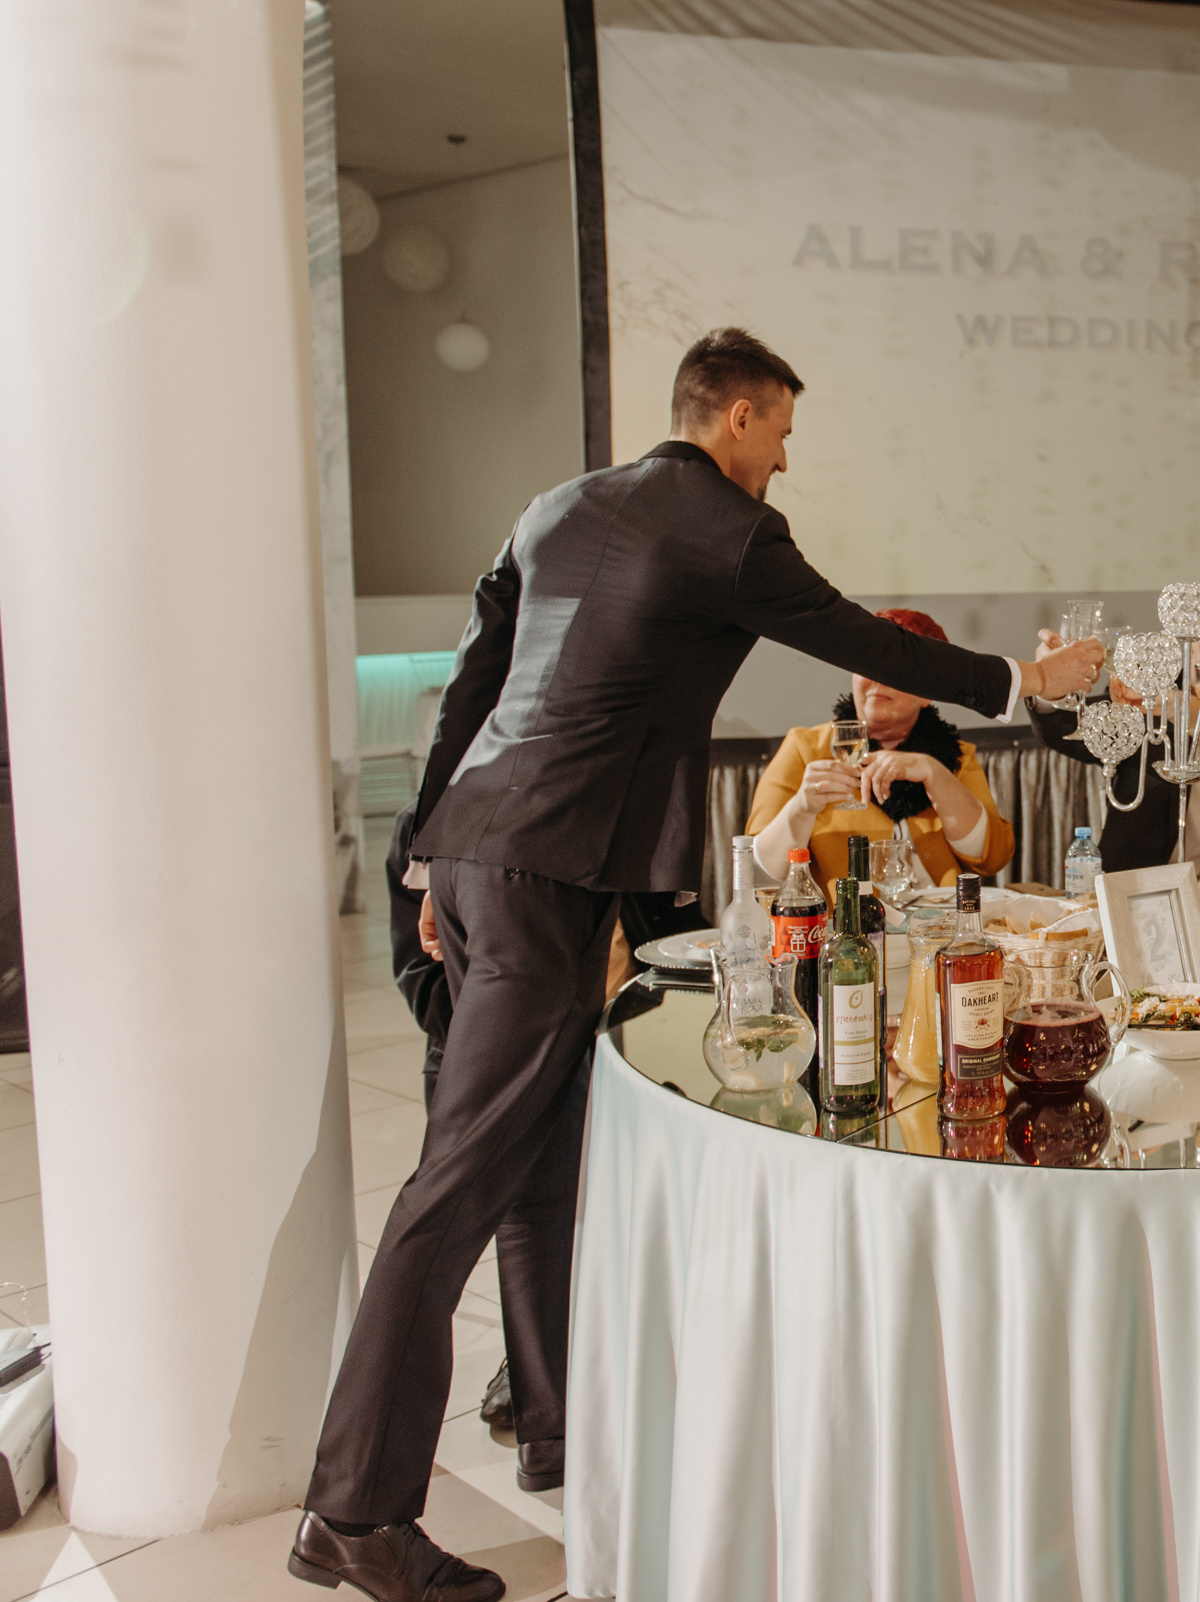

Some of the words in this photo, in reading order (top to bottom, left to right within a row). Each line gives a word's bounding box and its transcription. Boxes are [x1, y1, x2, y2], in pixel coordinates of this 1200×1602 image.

[791, 222, 1052, 280] ALENA
[1079, 235, 1125, 280] &
[1143, 919, 1167, 961] 2
[961, 992, 999, 1007] OAKHEART
